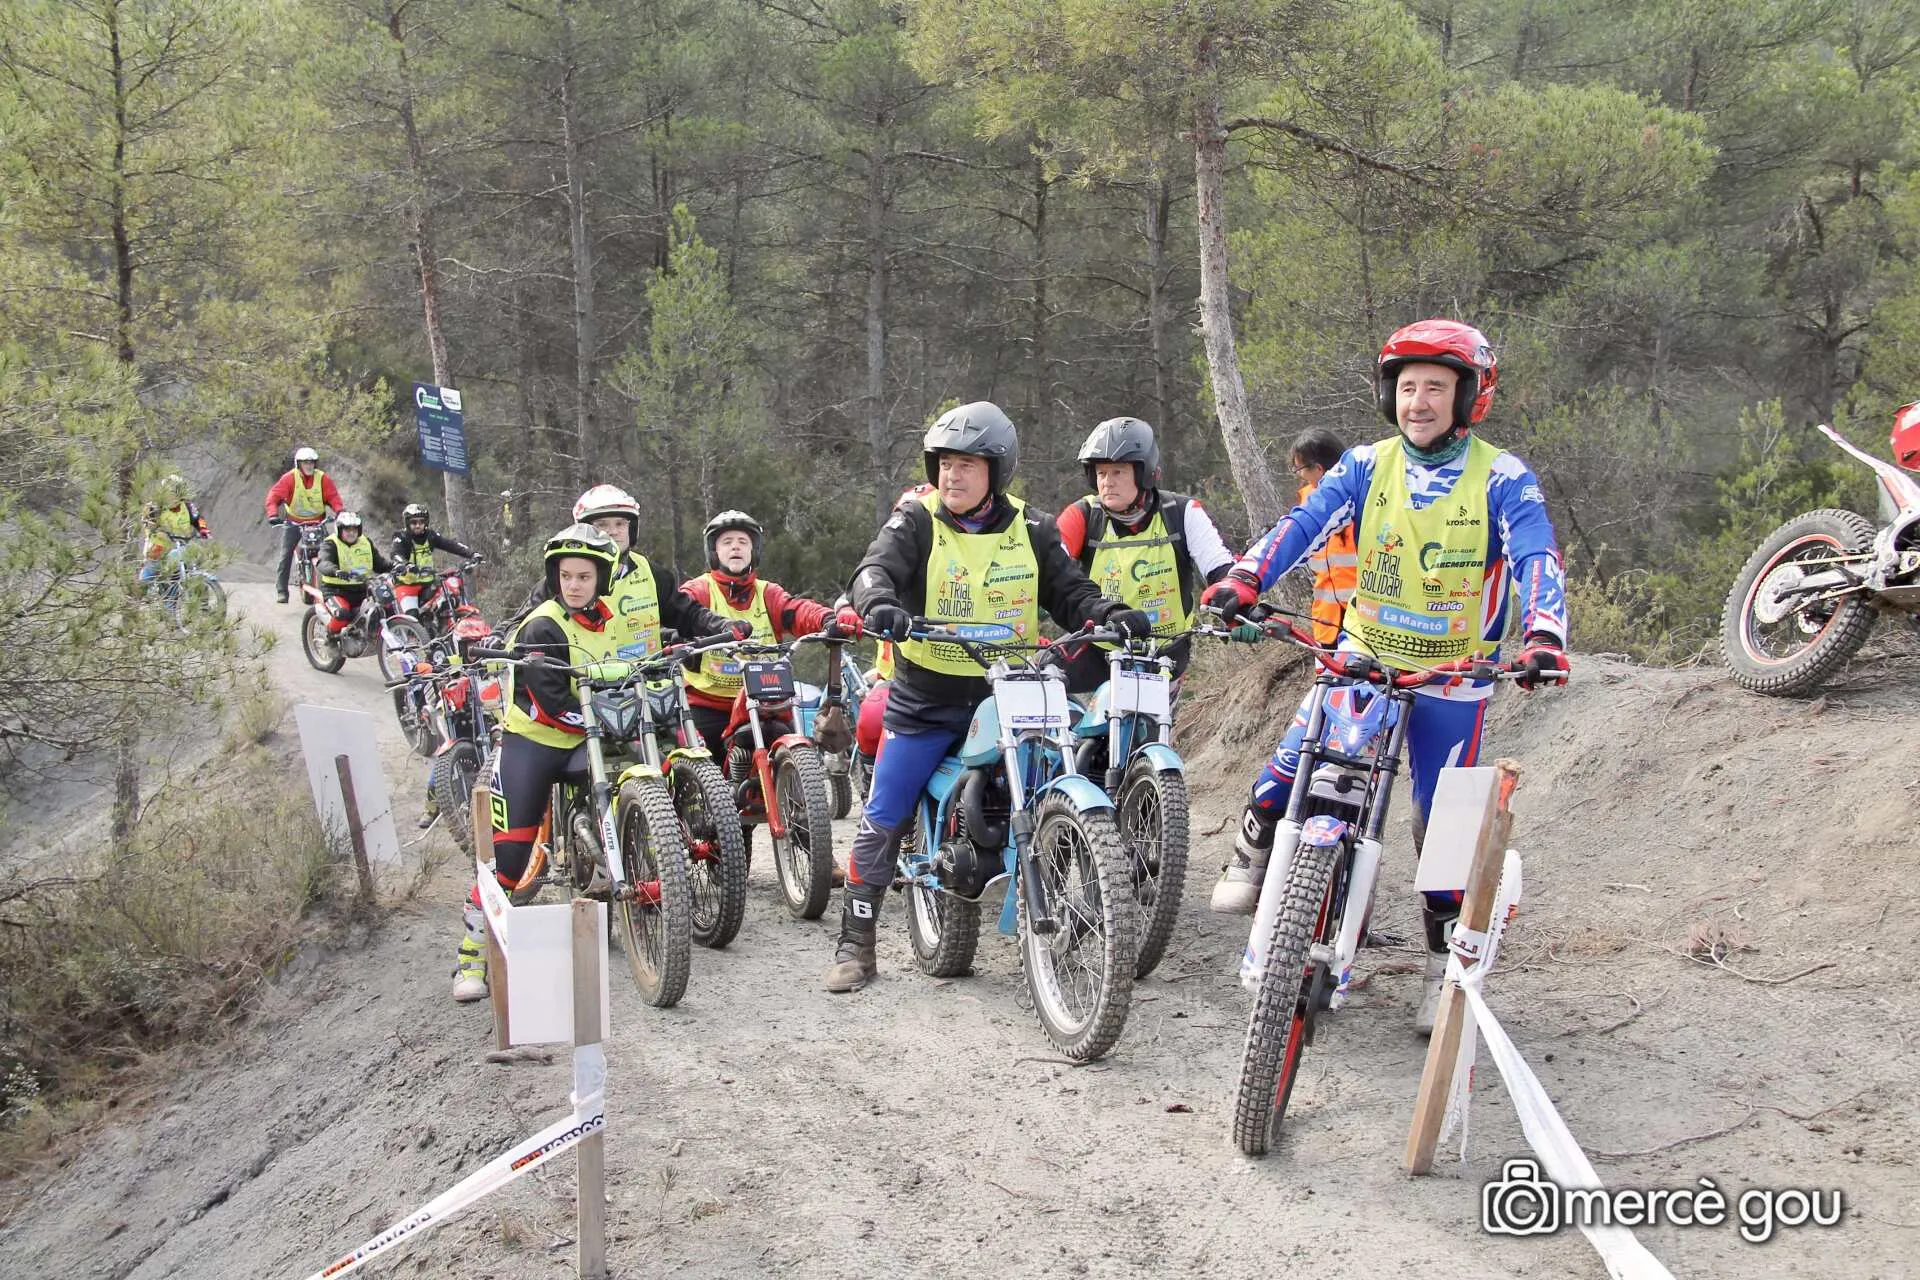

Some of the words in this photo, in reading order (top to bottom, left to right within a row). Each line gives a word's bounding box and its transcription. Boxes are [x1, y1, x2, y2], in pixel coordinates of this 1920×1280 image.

[1422, 581, 1441, 592] fcm
[1427, 600, 1464, 611] TrialGo
[1383, 609, 1398, 622] La
[1399, 614, 1443, 632] Marató
[604, 821, 615, 850] GALFER
